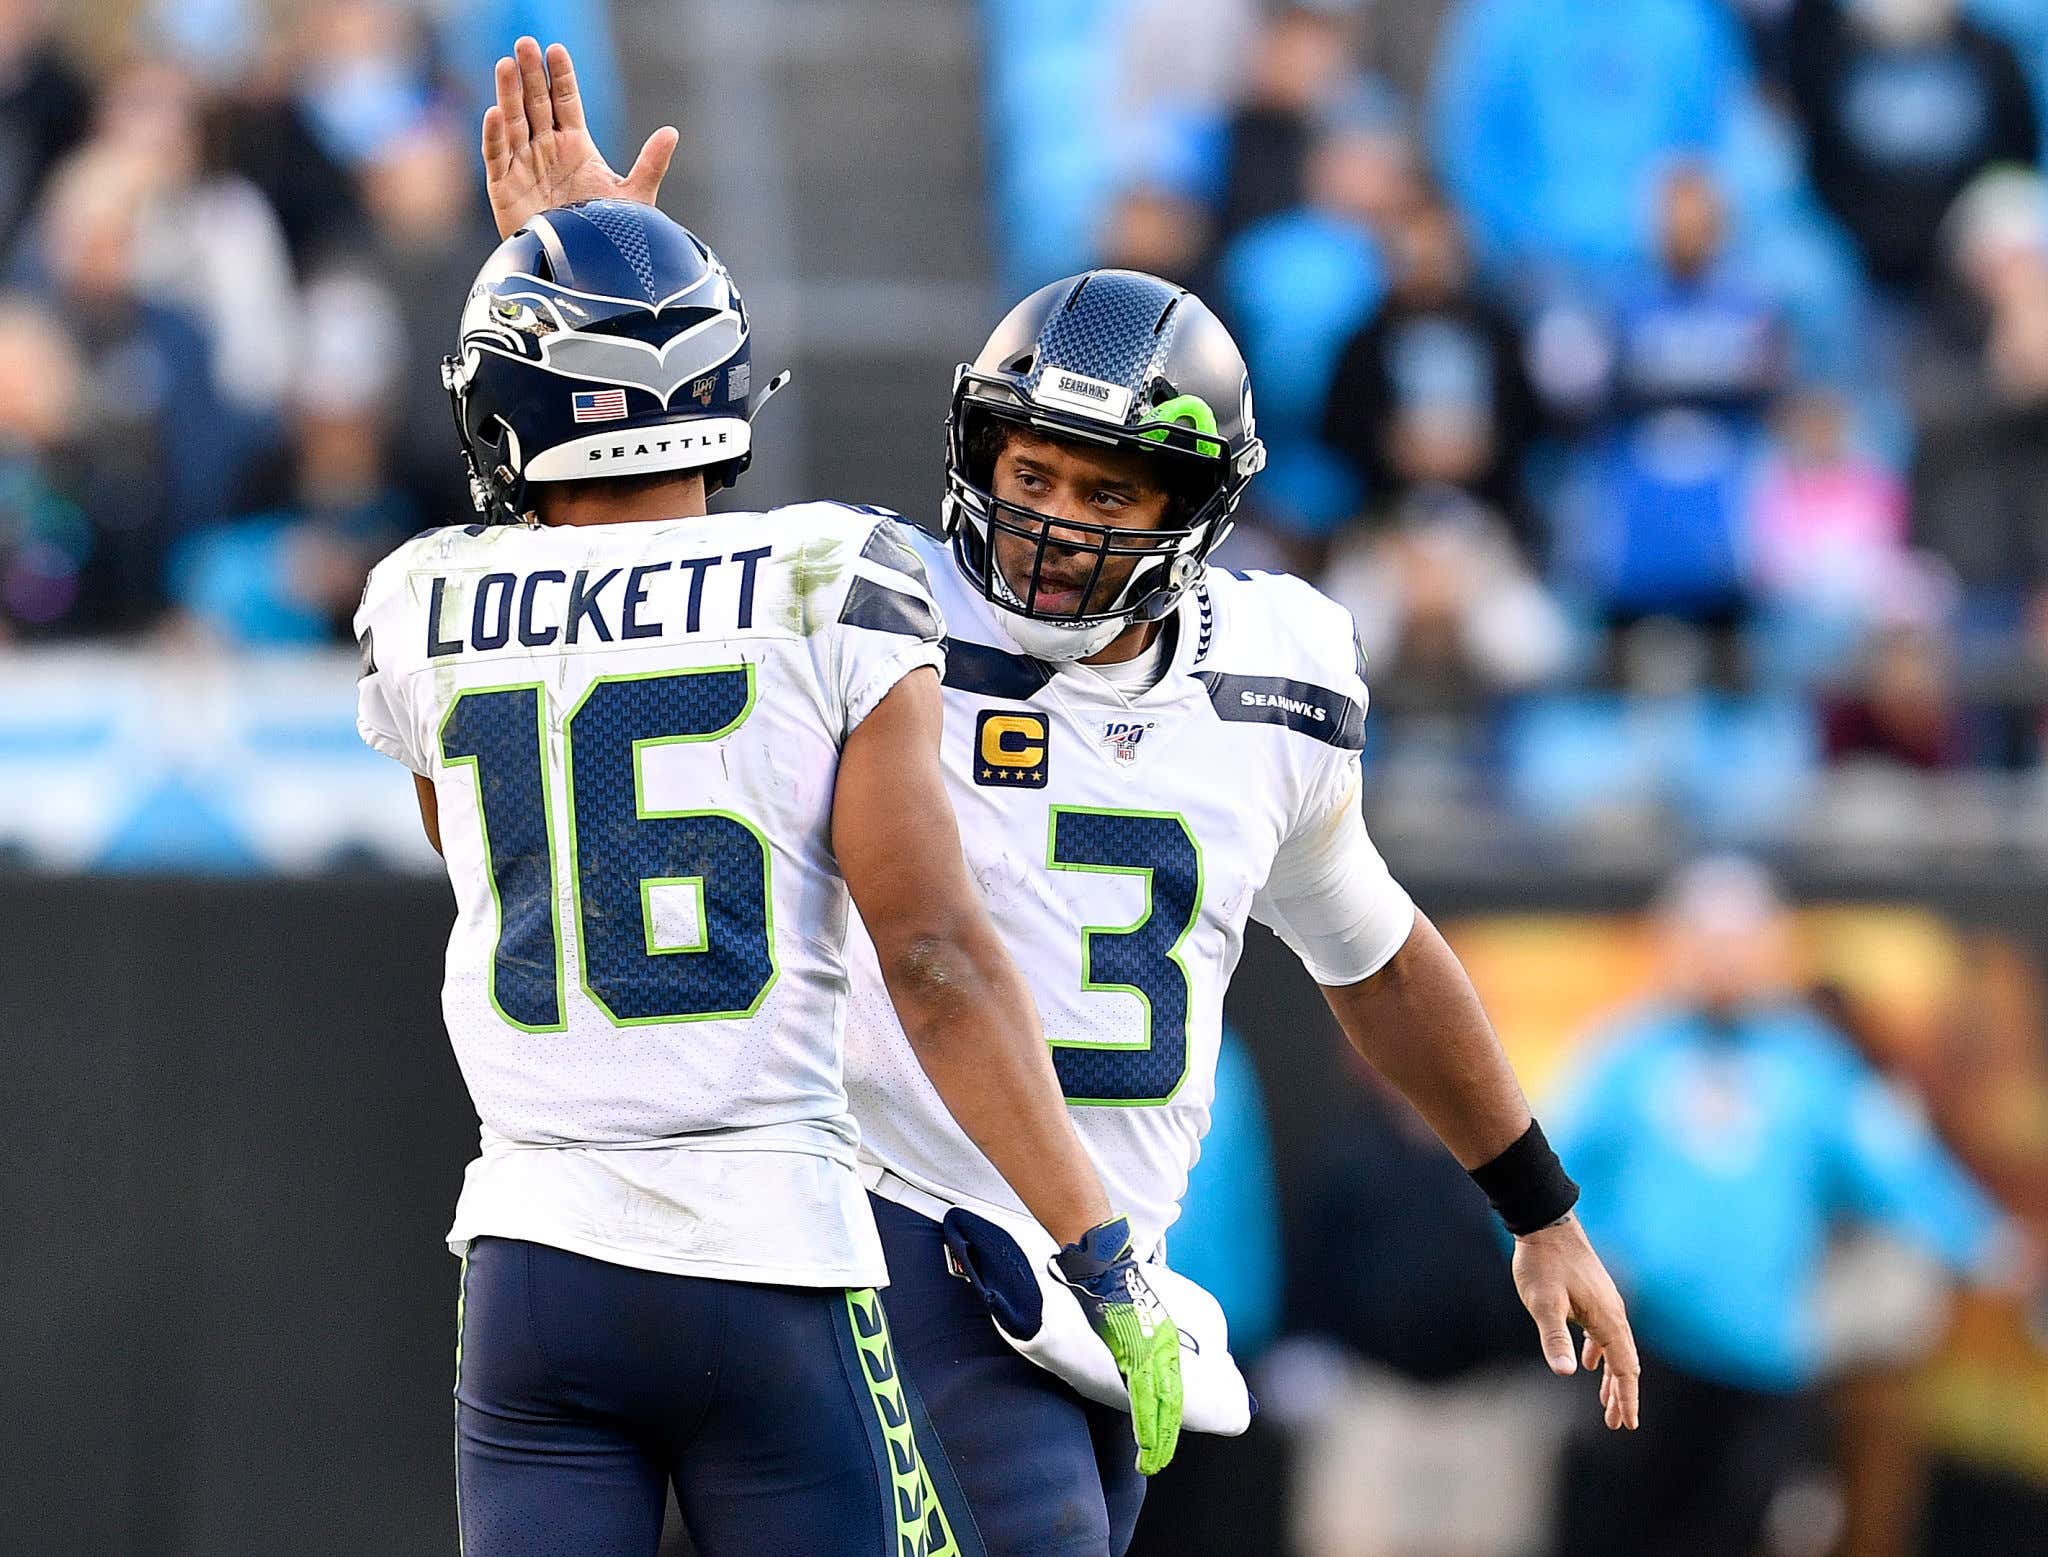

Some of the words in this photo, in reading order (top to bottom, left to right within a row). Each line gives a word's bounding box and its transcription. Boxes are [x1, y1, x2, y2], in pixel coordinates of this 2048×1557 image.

[589, 433, 727, 461] SEATTLE
[427, 546, 771, 658] LOCKETT
[981, 715, 1045, 768] C
[1104, 724, 1144, 744] 100
[437, 663, 780, 1034] 16
[1046, 804, 1204, 1107] 3
